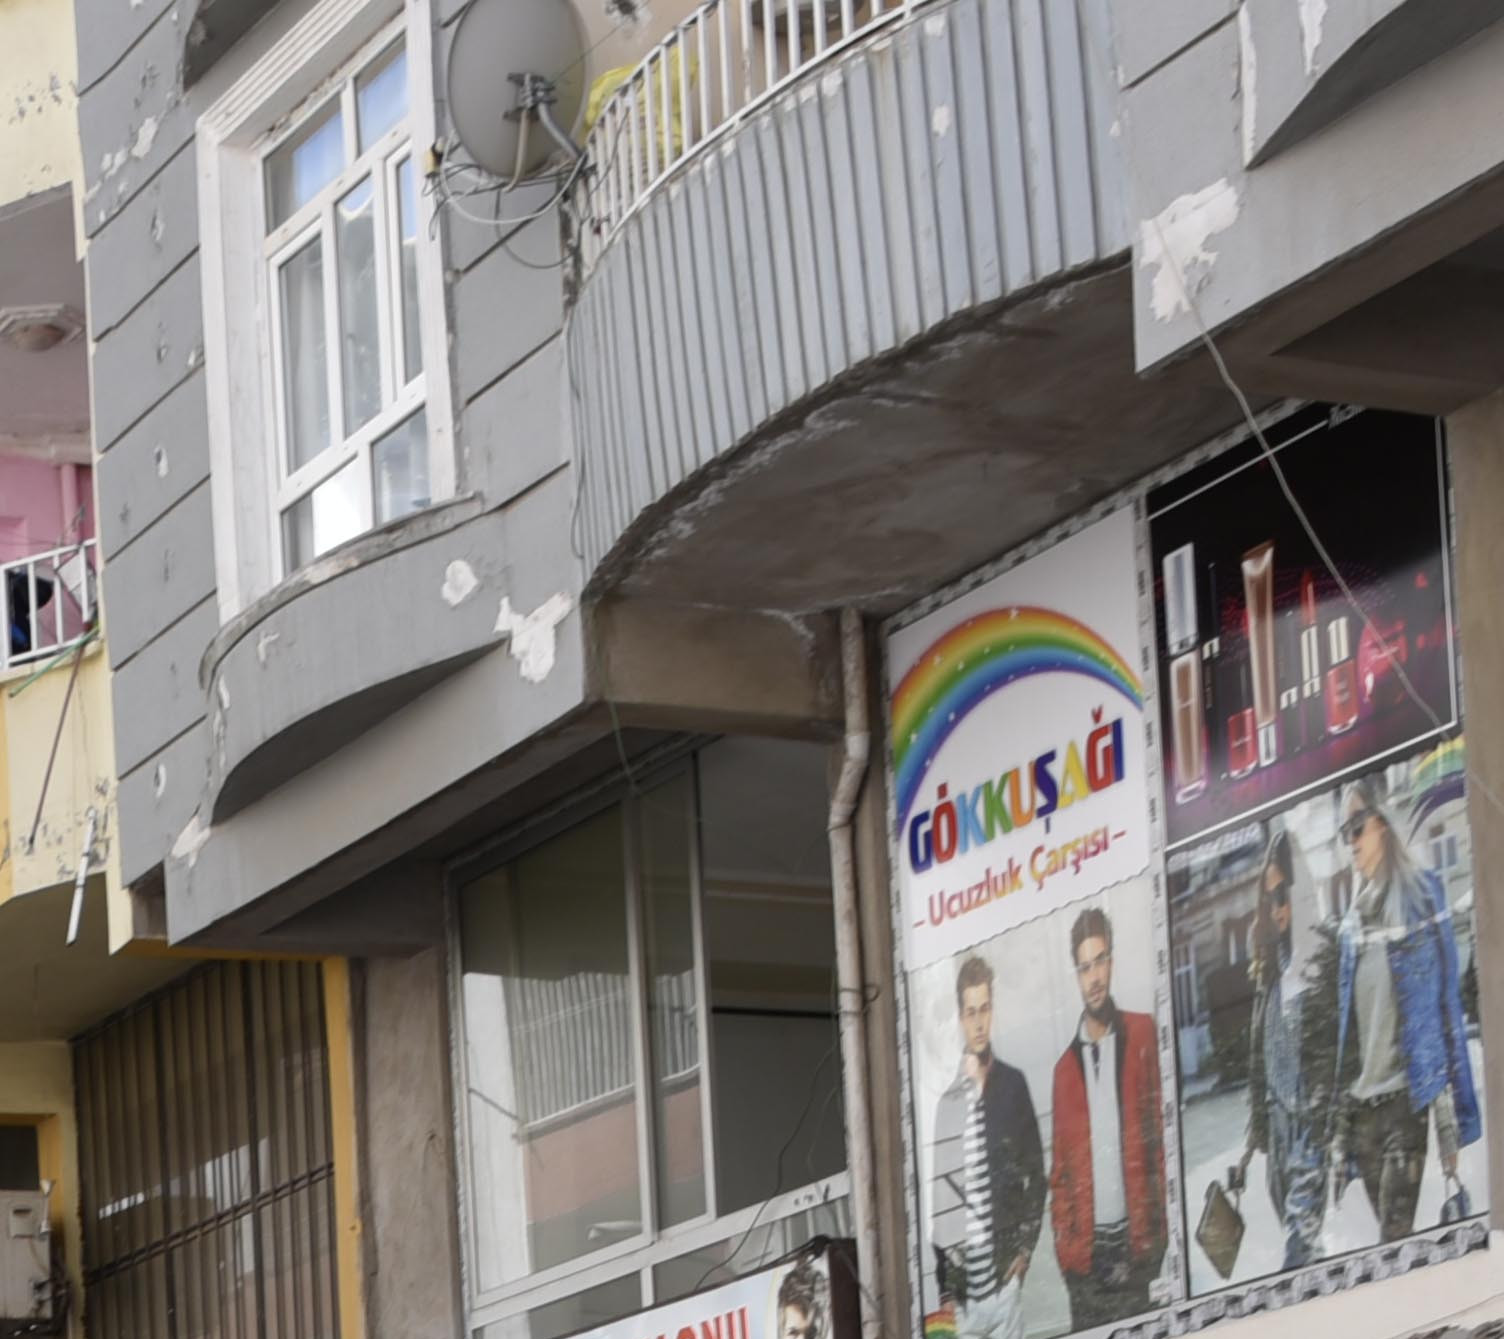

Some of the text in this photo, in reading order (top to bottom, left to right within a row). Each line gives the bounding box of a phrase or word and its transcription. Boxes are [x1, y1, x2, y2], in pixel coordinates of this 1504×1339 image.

[908, 706, 1126, 875] GÖKKUŞAĞI
[928, 827, 1110, 924] Ucuzluk Çarşısı
